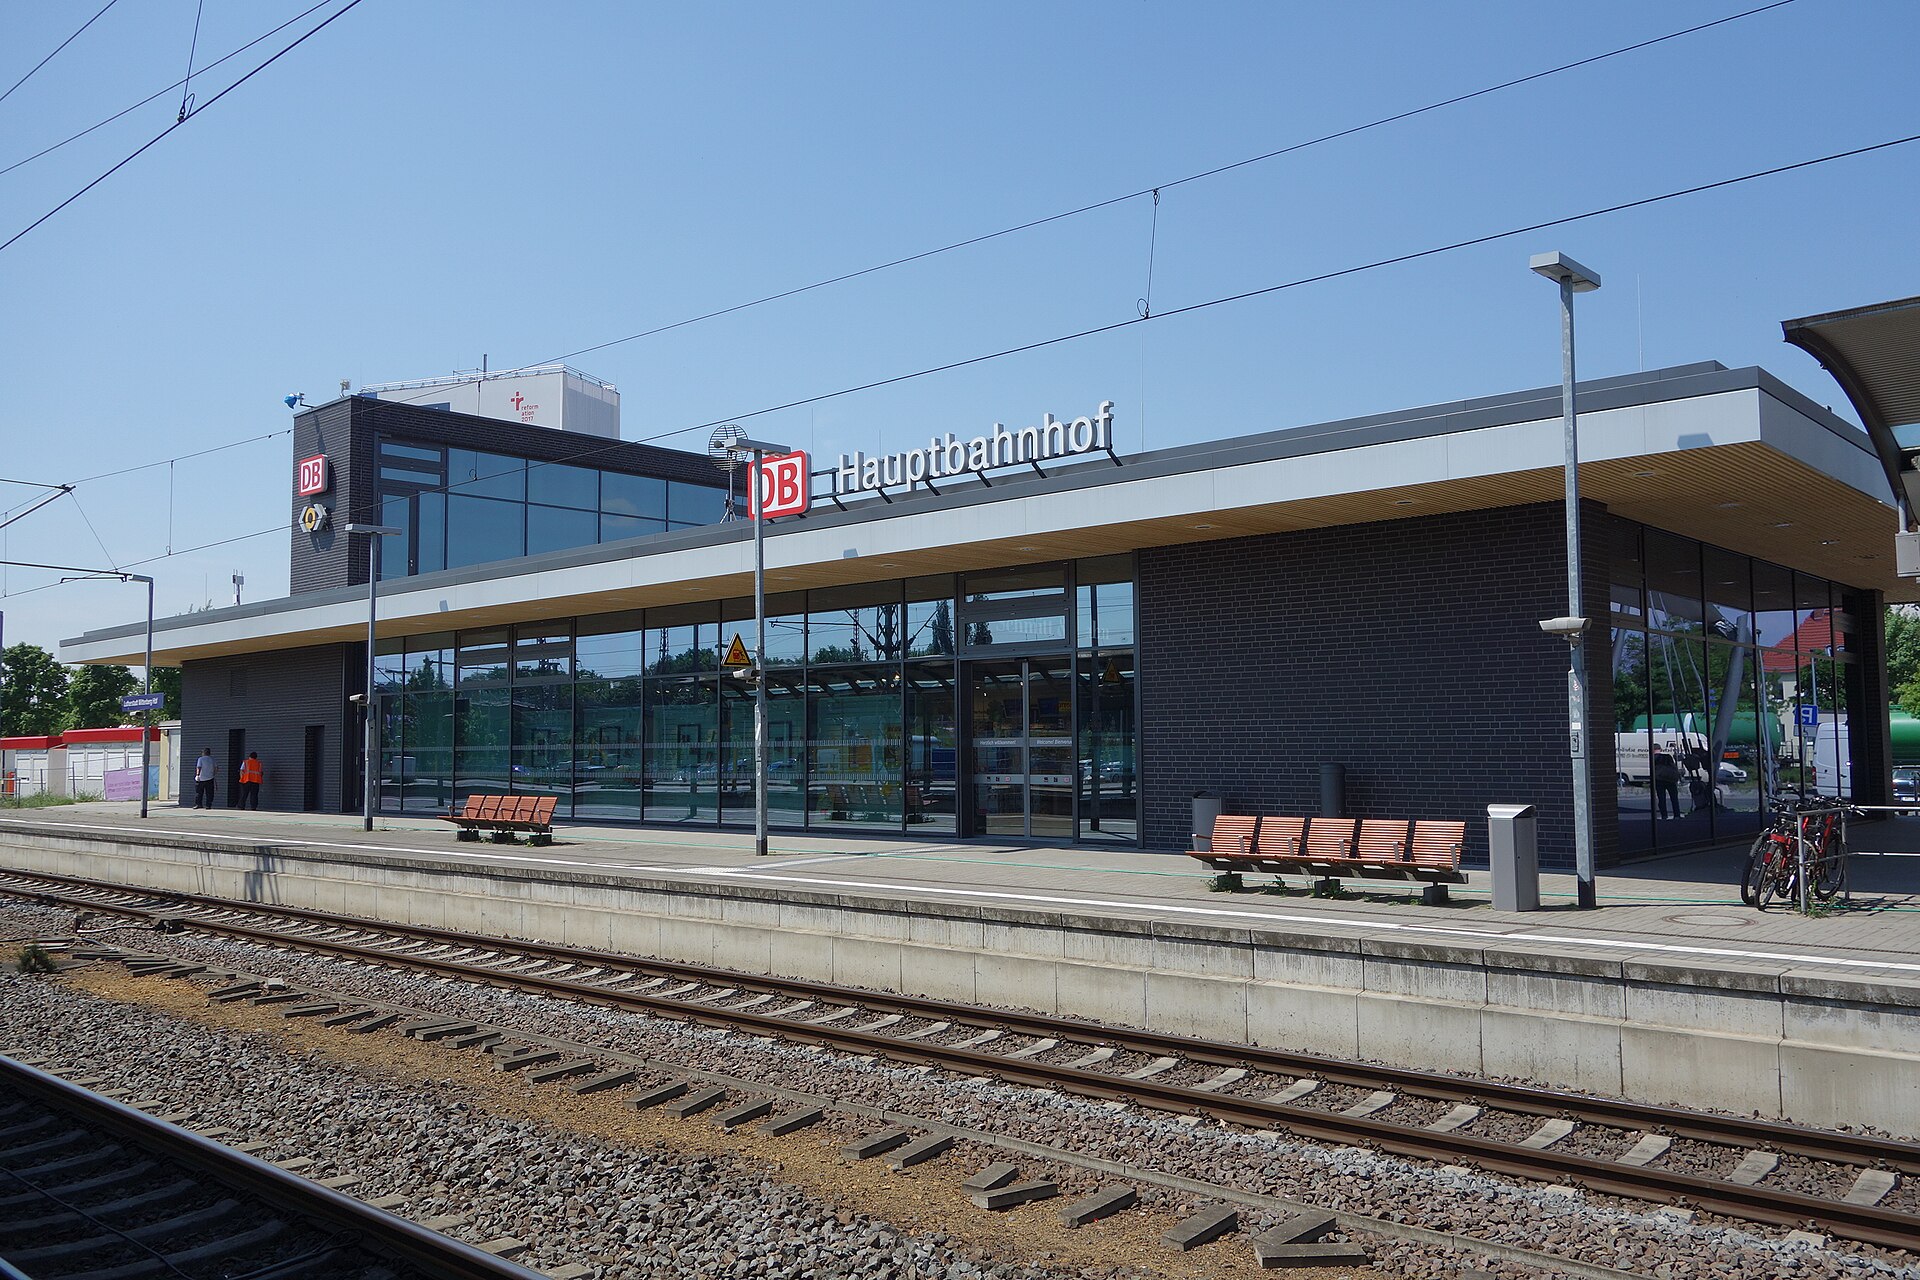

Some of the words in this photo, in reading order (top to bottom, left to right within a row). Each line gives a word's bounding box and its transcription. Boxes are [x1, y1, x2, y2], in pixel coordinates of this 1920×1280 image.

[839, 400, 1114, 493] Hauptbahnhof
[302, 462, 321, 490] DB
[758, 462, 799, 508] DB
